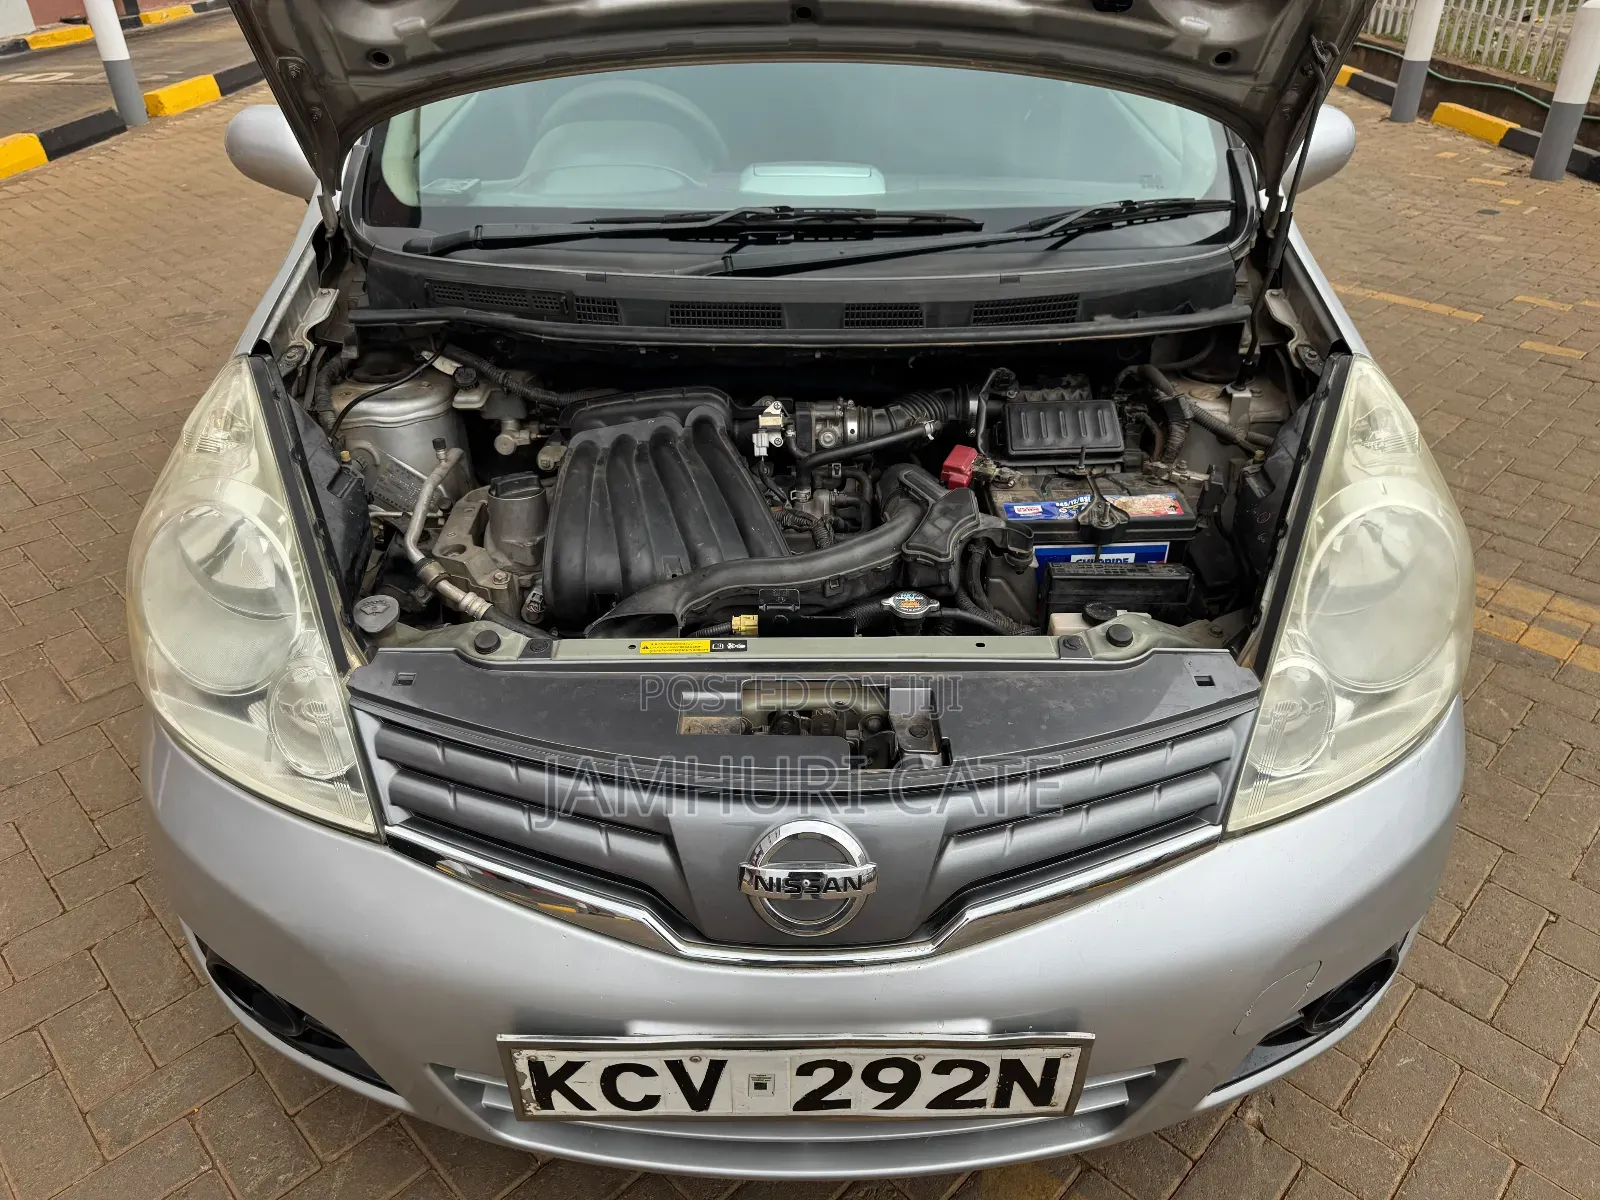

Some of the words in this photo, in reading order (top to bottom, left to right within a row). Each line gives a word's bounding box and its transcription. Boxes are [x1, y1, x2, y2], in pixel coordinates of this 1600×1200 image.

[754, 874, 863, 894] NISSAN
[527, 1058, 728, 1112] KCV
[791, 1056, 1063, 1111] 292N
